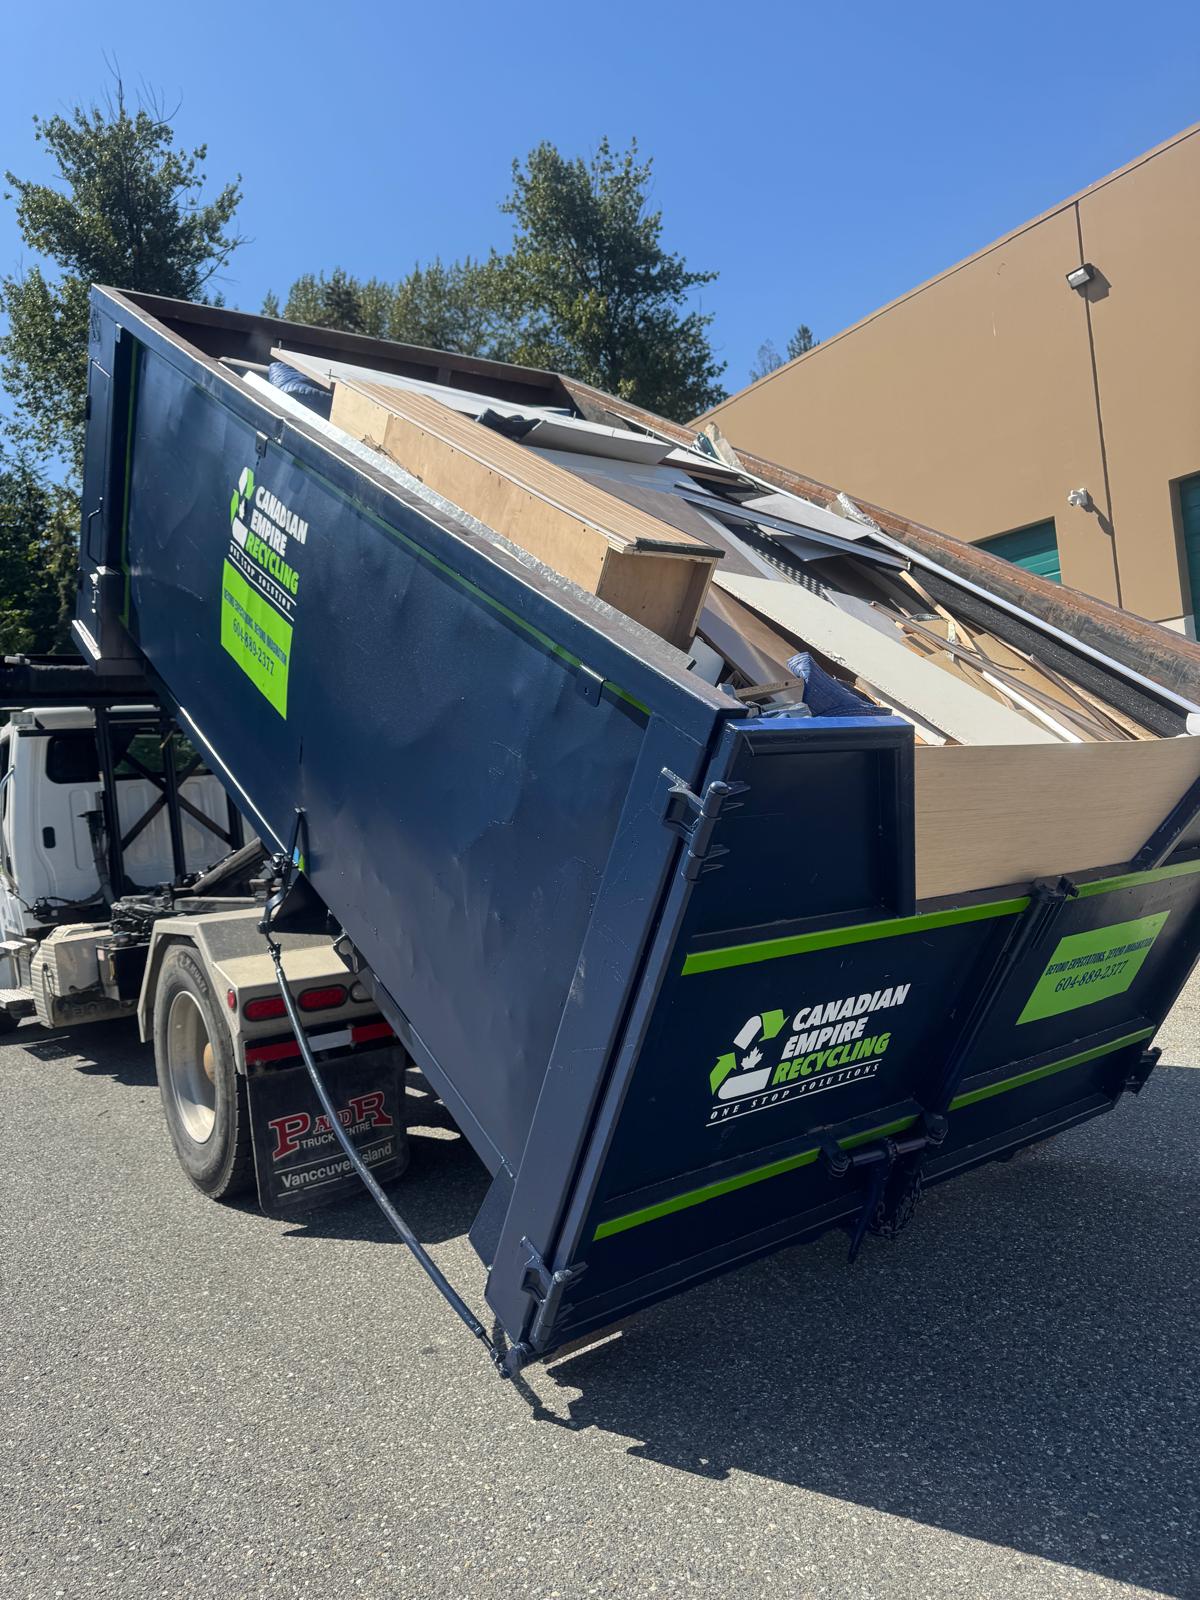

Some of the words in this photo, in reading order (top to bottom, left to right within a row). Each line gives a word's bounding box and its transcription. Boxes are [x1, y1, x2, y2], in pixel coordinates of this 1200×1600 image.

[250, 508, 288, 557] EMPIRE
[255, 486, 308, 545] CANADIAN
[245, 532, 300, 596] RECYCLING
[1055, 959, 1129, 993] 604-889-2377
[792, 983, 912, 1032] CANADIAN
[771, 1032, 892, 1086] RECYCLING
[780, 1016, 869, 1061] EMPIRE
[709, 1104, 740, 1121] ONE
[751, 1089, 790, 1109] STOP
[800, 1062, 880, 1093] SOLUTIONS
[268, 1112, 311, 1162] P
[313, 1108, 353, 1135] AD
[349, 1090, 393, 1127] R
[301, 1132, 336, 1150] TRUCK
[345, 1120, 372, 1136] ENTRE
[360, 1142, 393, 1165] sland
